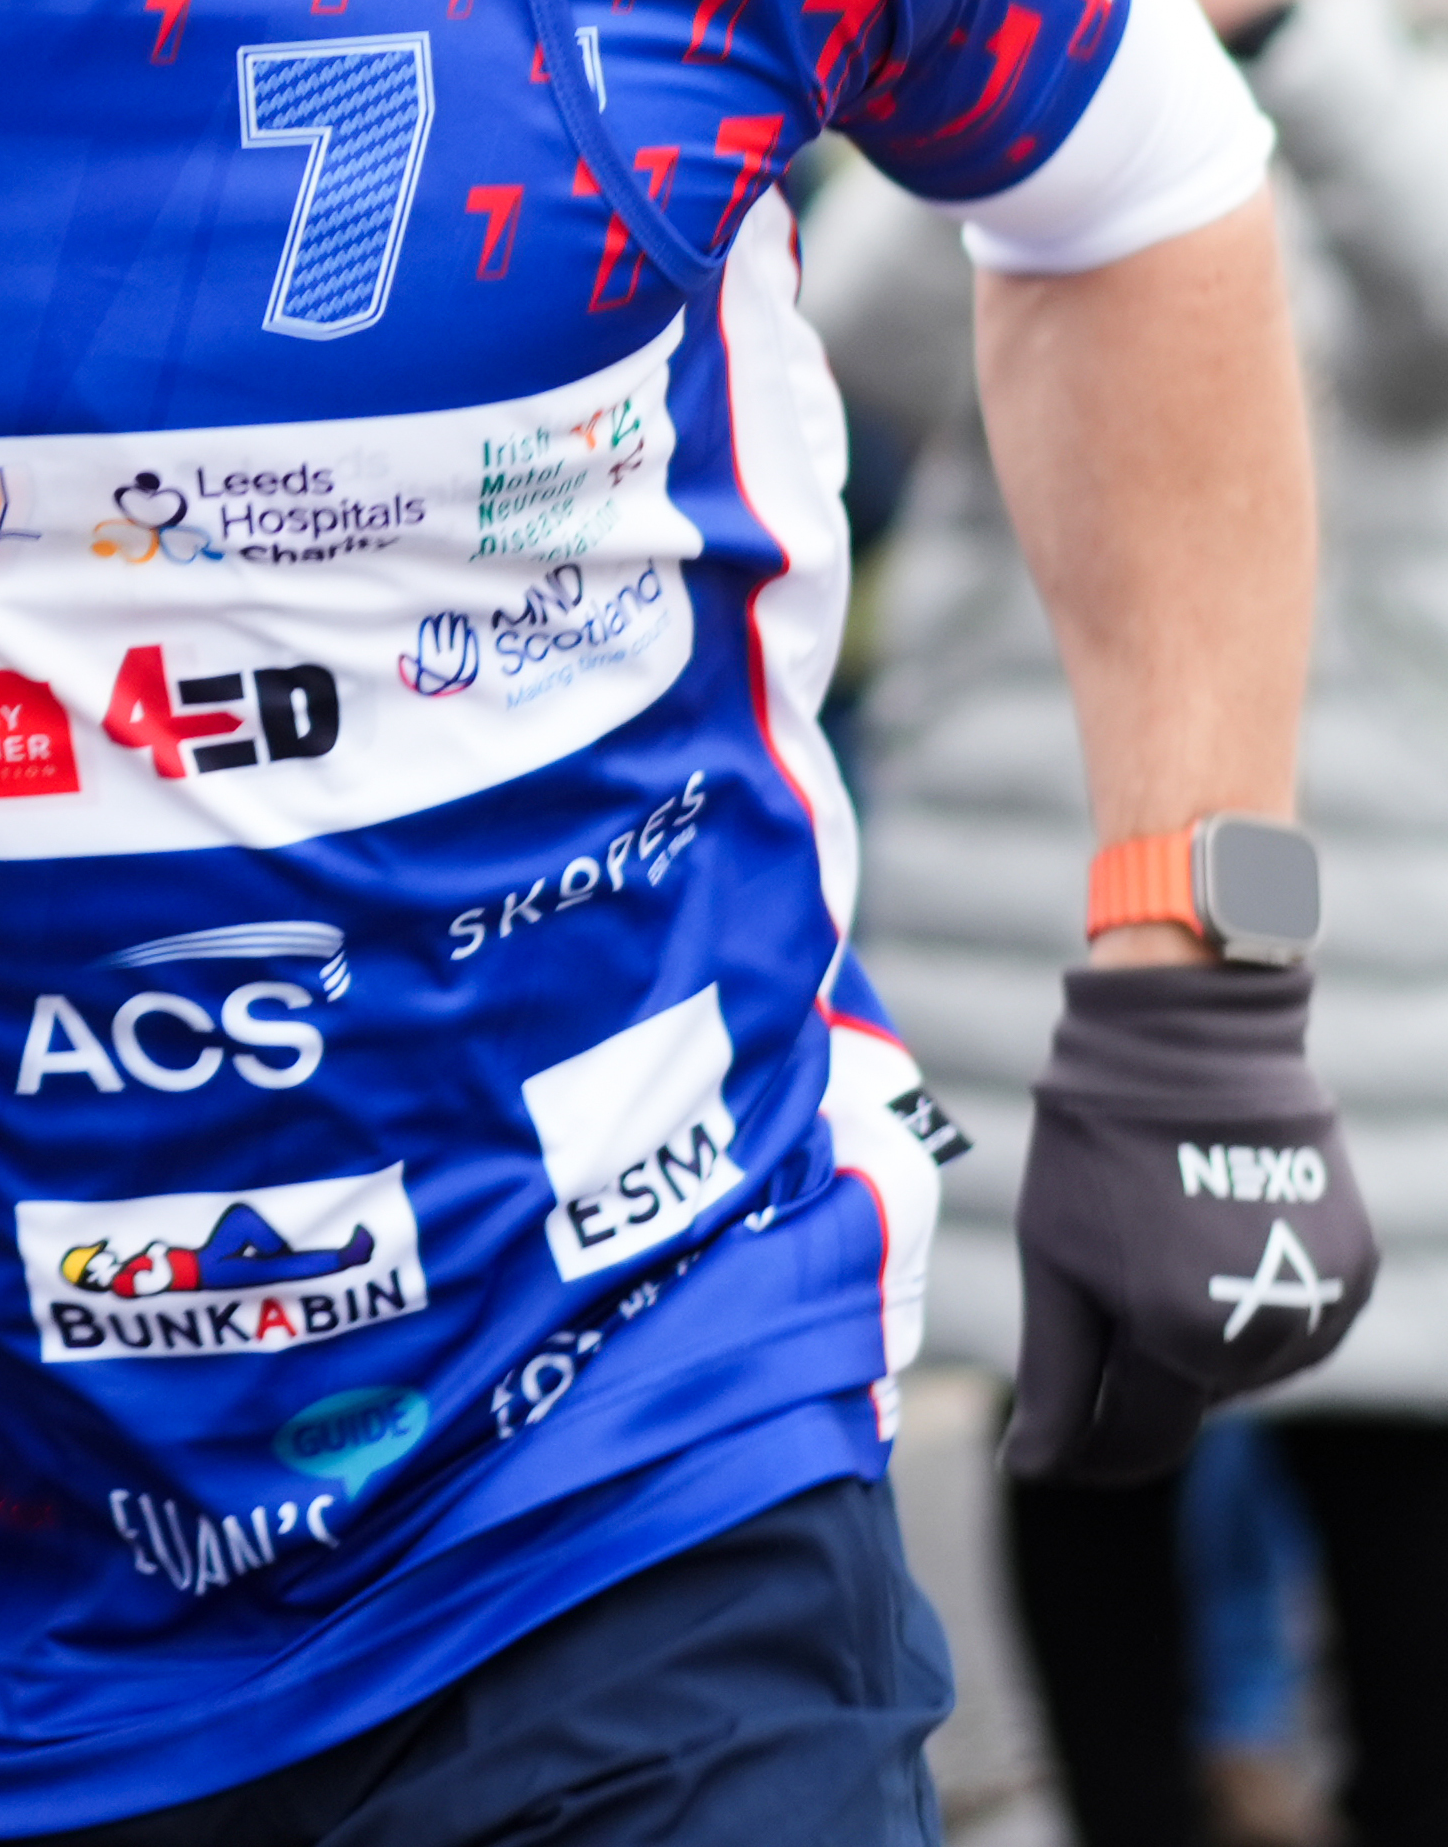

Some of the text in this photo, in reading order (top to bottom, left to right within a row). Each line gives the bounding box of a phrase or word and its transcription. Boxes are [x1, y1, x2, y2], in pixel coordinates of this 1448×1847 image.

[236, 28, 436, 341] 7
[195, 461, 335, 499] Leeds
[482, 425, 550, 469] Irish
[221, 492, 427, 541] Hospitals
[494, 556, 663, 677] Scotland
[14, 981, 326, 1097] ACS
[565, 1122, 720, 1251] ESM
[48, 1269, 410, 1351] BUNKABIN
